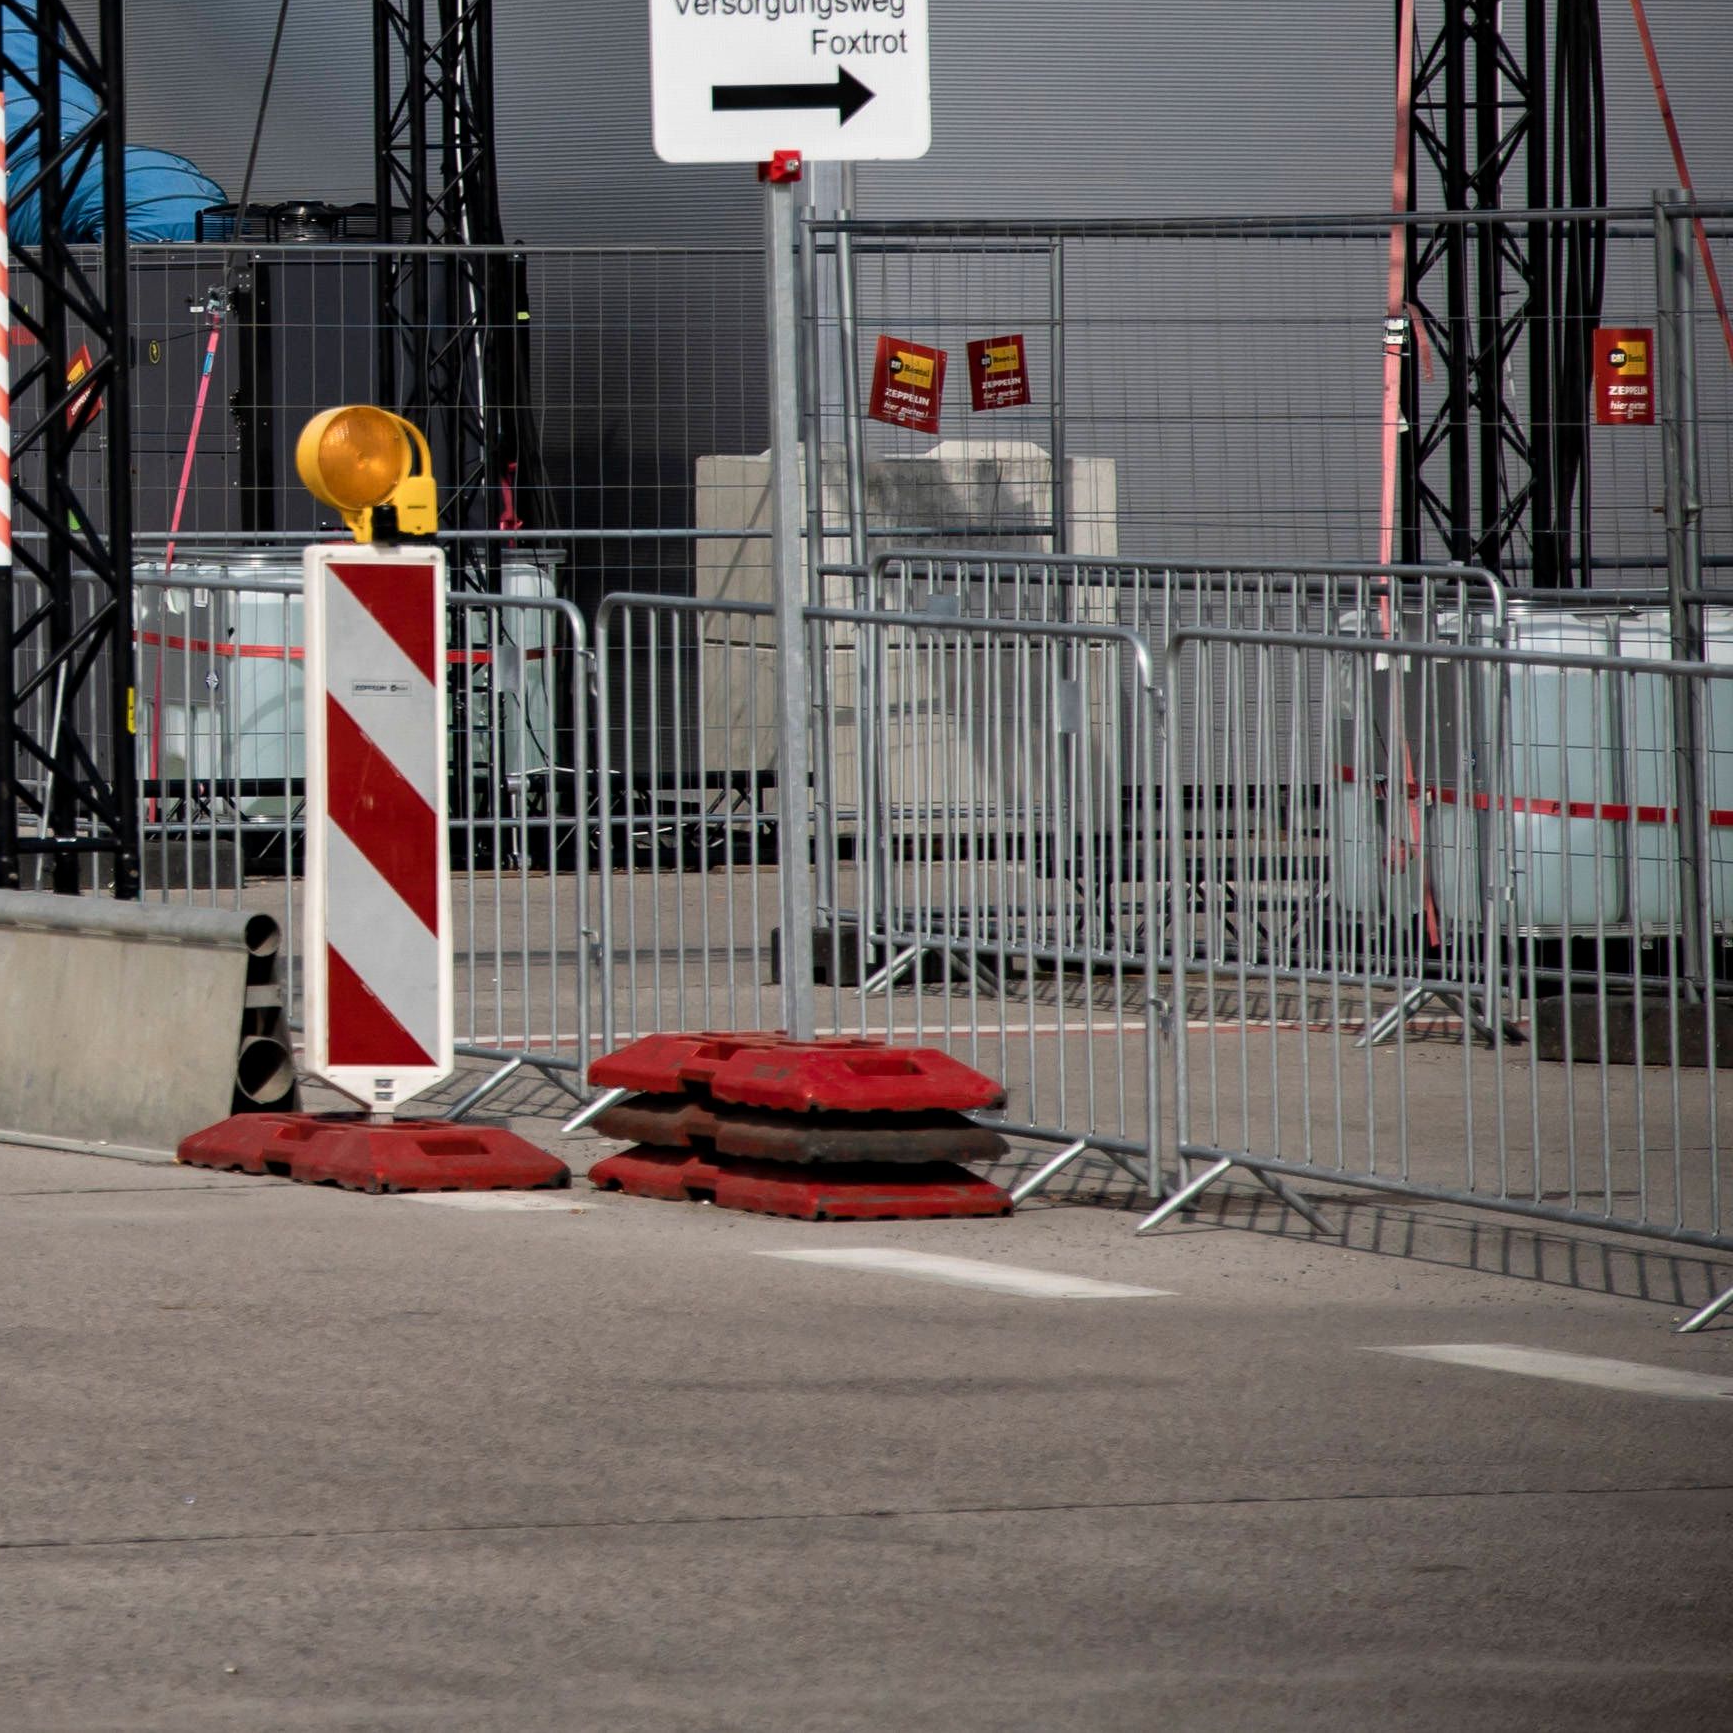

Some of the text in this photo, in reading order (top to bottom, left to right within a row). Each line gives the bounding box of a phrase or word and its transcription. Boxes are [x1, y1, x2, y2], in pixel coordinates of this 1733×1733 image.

[811, 29, 908, 55] Foxtrot
[982, 376, 1022, 390] ZEPPELIN
[1608, 385, 1648, 396] ZEPPELIN
[884, 387, 931, 407] ZEPPELIN
